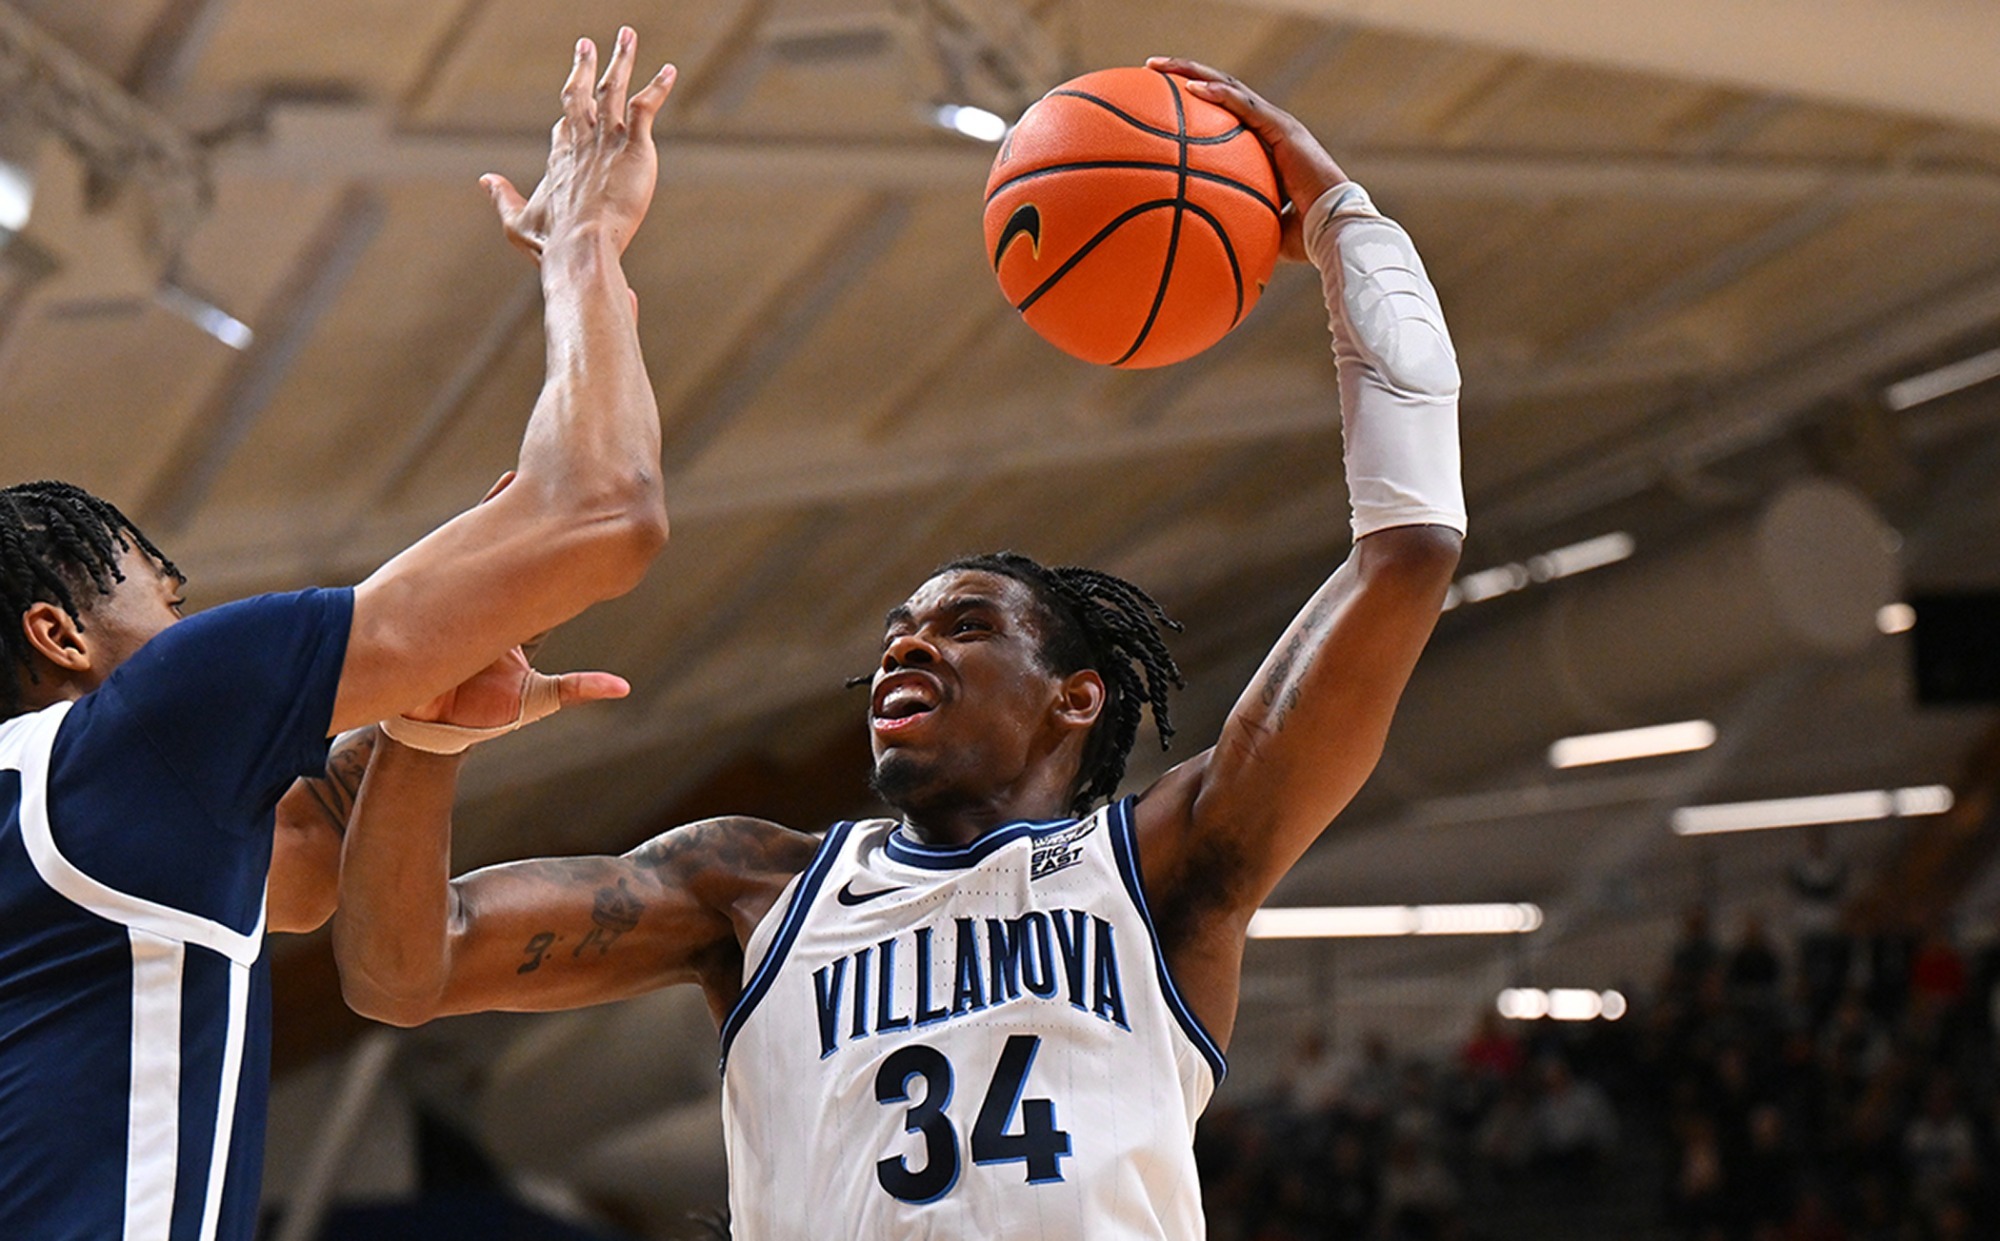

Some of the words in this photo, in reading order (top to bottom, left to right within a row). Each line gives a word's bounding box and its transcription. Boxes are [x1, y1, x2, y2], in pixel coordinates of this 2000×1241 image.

[1031, 847, 1083, 876] EAST
[1032, 847, 1068, 863] BIG
[812, 909, 1132, 1059] VILLANOVA
[875, 1034, 1073, 1205] 34
